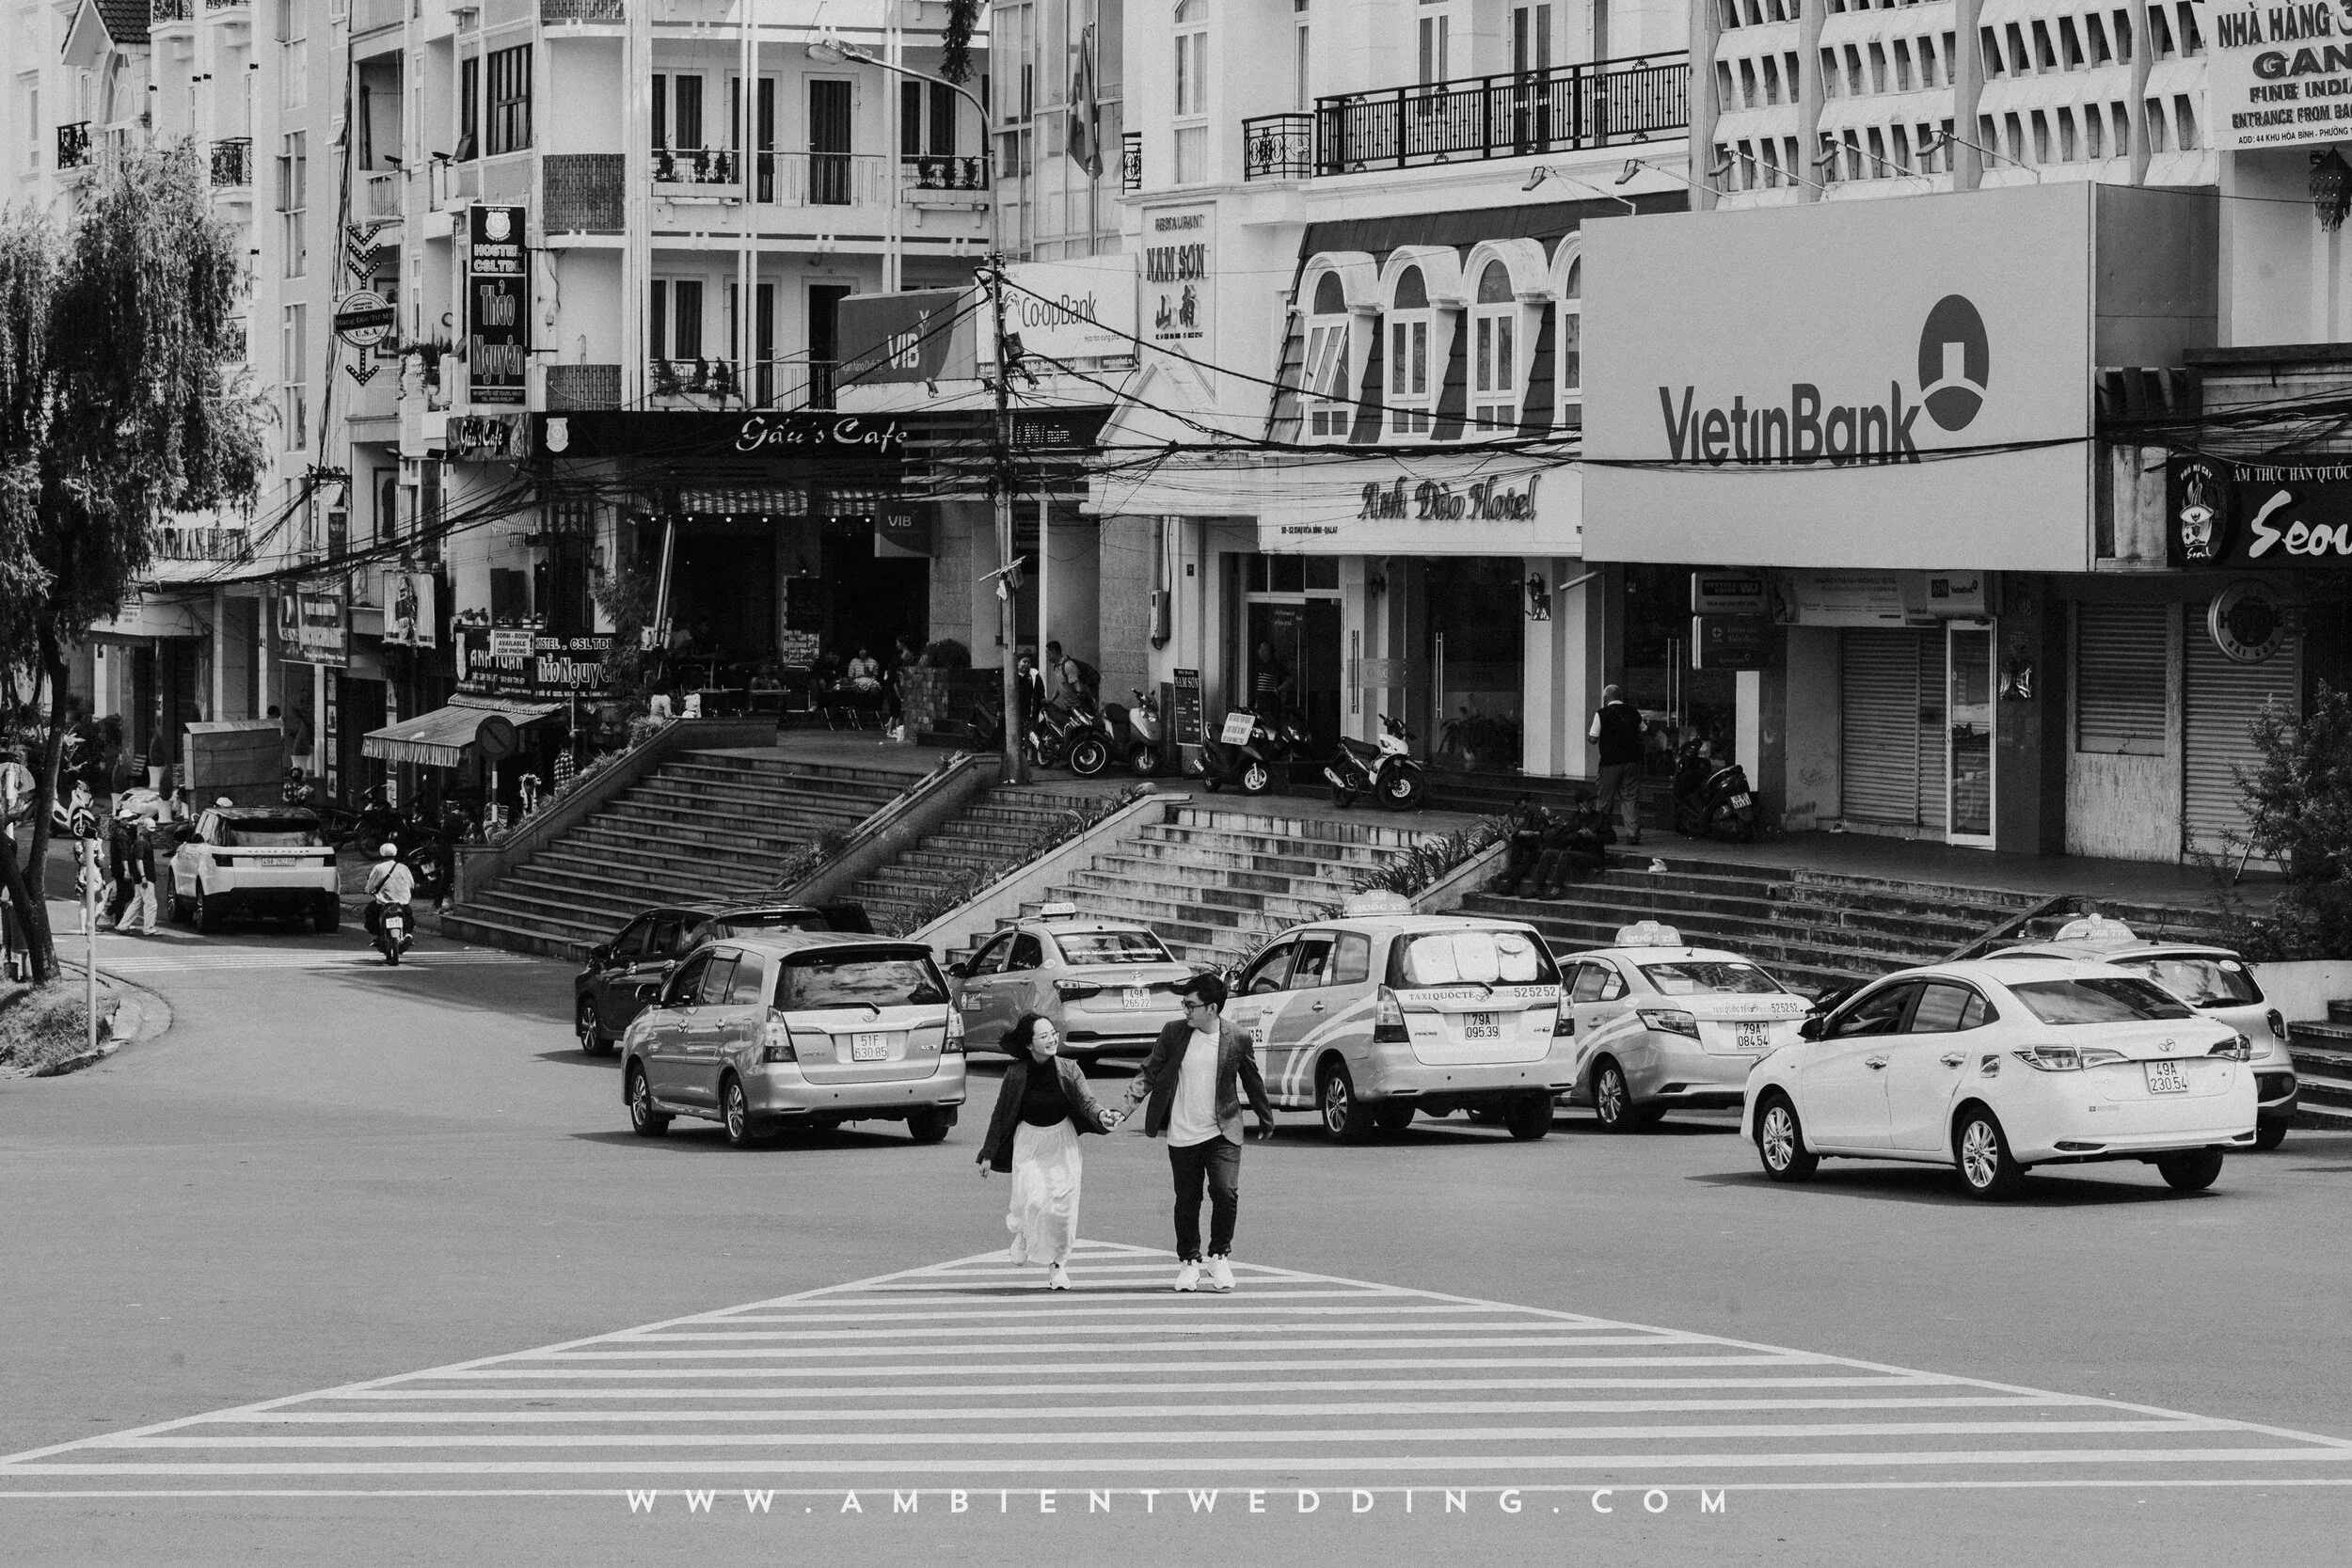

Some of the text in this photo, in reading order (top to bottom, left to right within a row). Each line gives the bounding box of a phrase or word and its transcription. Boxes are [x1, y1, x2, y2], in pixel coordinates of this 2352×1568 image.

[2217, 0, 2331, 48] NHÀ HÀNG
[2249, 77, 2352, 103] FINE INDI
[2232, 103, 2352, 129] ENTRANCE FROM BA
[2256, 134, 2265, 142] 44
[2265, 133, 2280, 142] KHU
[1155, 214, 1205, 231] RESTAURANT
[473, 244, 522, 257] HOSTEL
[473, 259, 522, 273] CSLTDL
[1147, 246, 1175, 282] NAM
[480, 279, 516, 326] Thảo
[887, 333, 920, 370] VIB
[472, 334, 523, 385] Nguyên
[1658, 379, 1922, 467] VietinBank
[833, 417, 907, 453] Cafe
[2290, 462, 2312, 482] HÀN
[2317, 458, 2352, 483] QUỐC
[1357, 473, 1542, 520] Anh Đào Hotel
[887, 515, 912, 527] VIB
[2186, 546, 2212, 560] Seoul
[1129, 989, 1144, 999] 49A
[1408, 992, 1432, 1001] TAXI
[1514, 987, 1557, 998] 525252
[1771, 1003, 1799, 1014] 525252
[1471, 1014, 1491, 1026] 79A
[1466, 1025, 1499, 1038] 095.39
[1743, 1022, 1761, 1035] 79A
[861, 1036, 880, 1047] 51F
[1738, 1035, 1769, 1047] 084.54
[2156, 1062, 2178, 1076] 49A
[2150, 1075, 2188, 1092] 230.54
